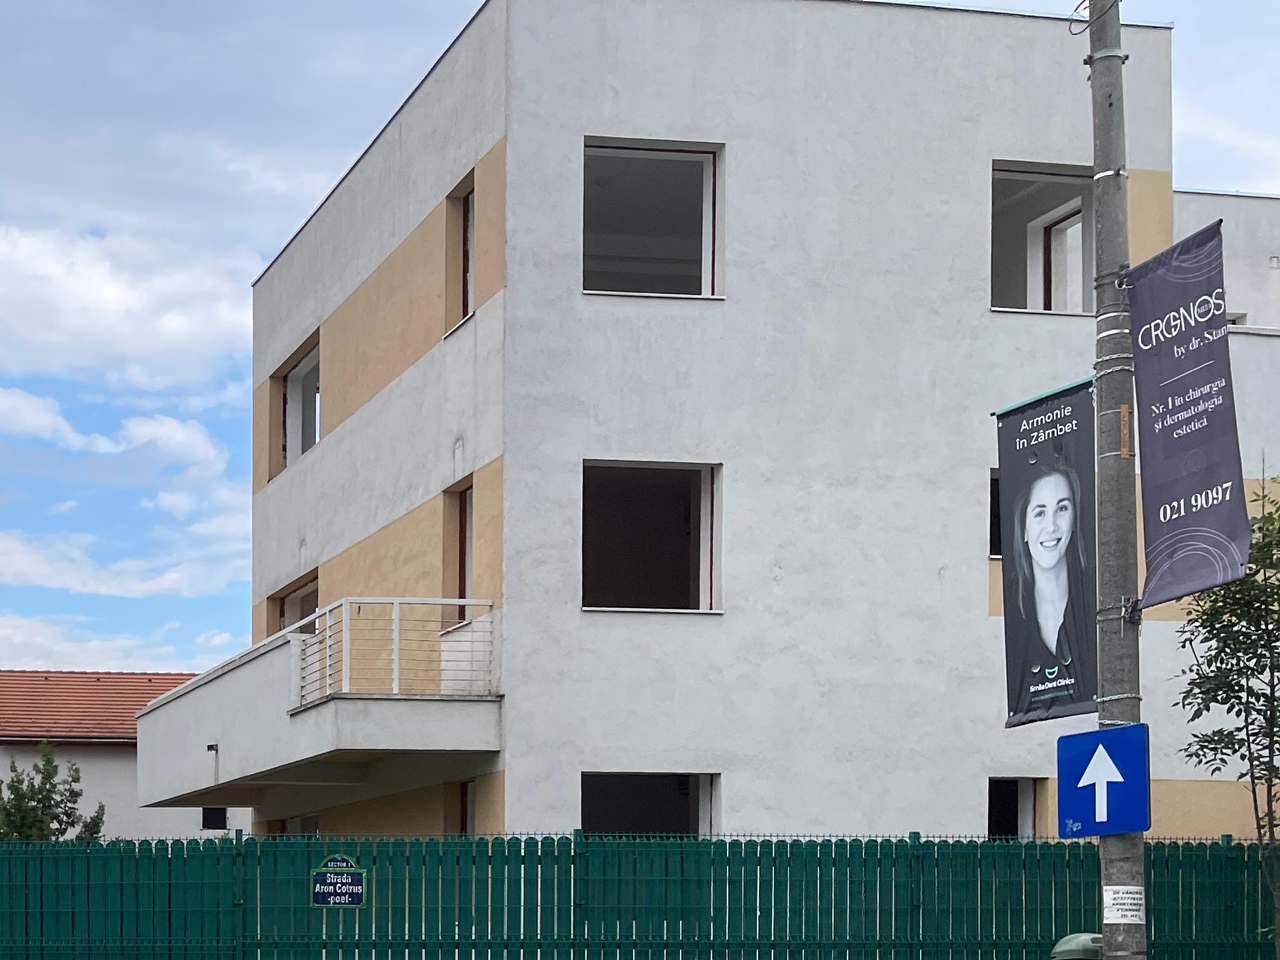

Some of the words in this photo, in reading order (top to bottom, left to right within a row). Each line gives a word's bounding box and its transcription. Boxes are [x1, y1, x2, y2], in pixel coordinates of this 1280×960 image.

[1174, 345, 1187, 359] by
[1189, 337, 1203, 351] dr.
[1151, 403, 1167, 417] Nr.
[1168, 396, 1173, 410] 1
[1185, 378, 1226, 402] chirurgia
[1163, 395, 1223, 427] dermatologia
[1020, 405, 1072, 433] Armonie
[1030, 419, 1078, 445] Zâmbet
[1159, 498, 1186, 523] 021
[1191, 481, 1233, 512] 9097
[315, 883, 334, 893] Aron
[326, 873, 352, 883] Strada
